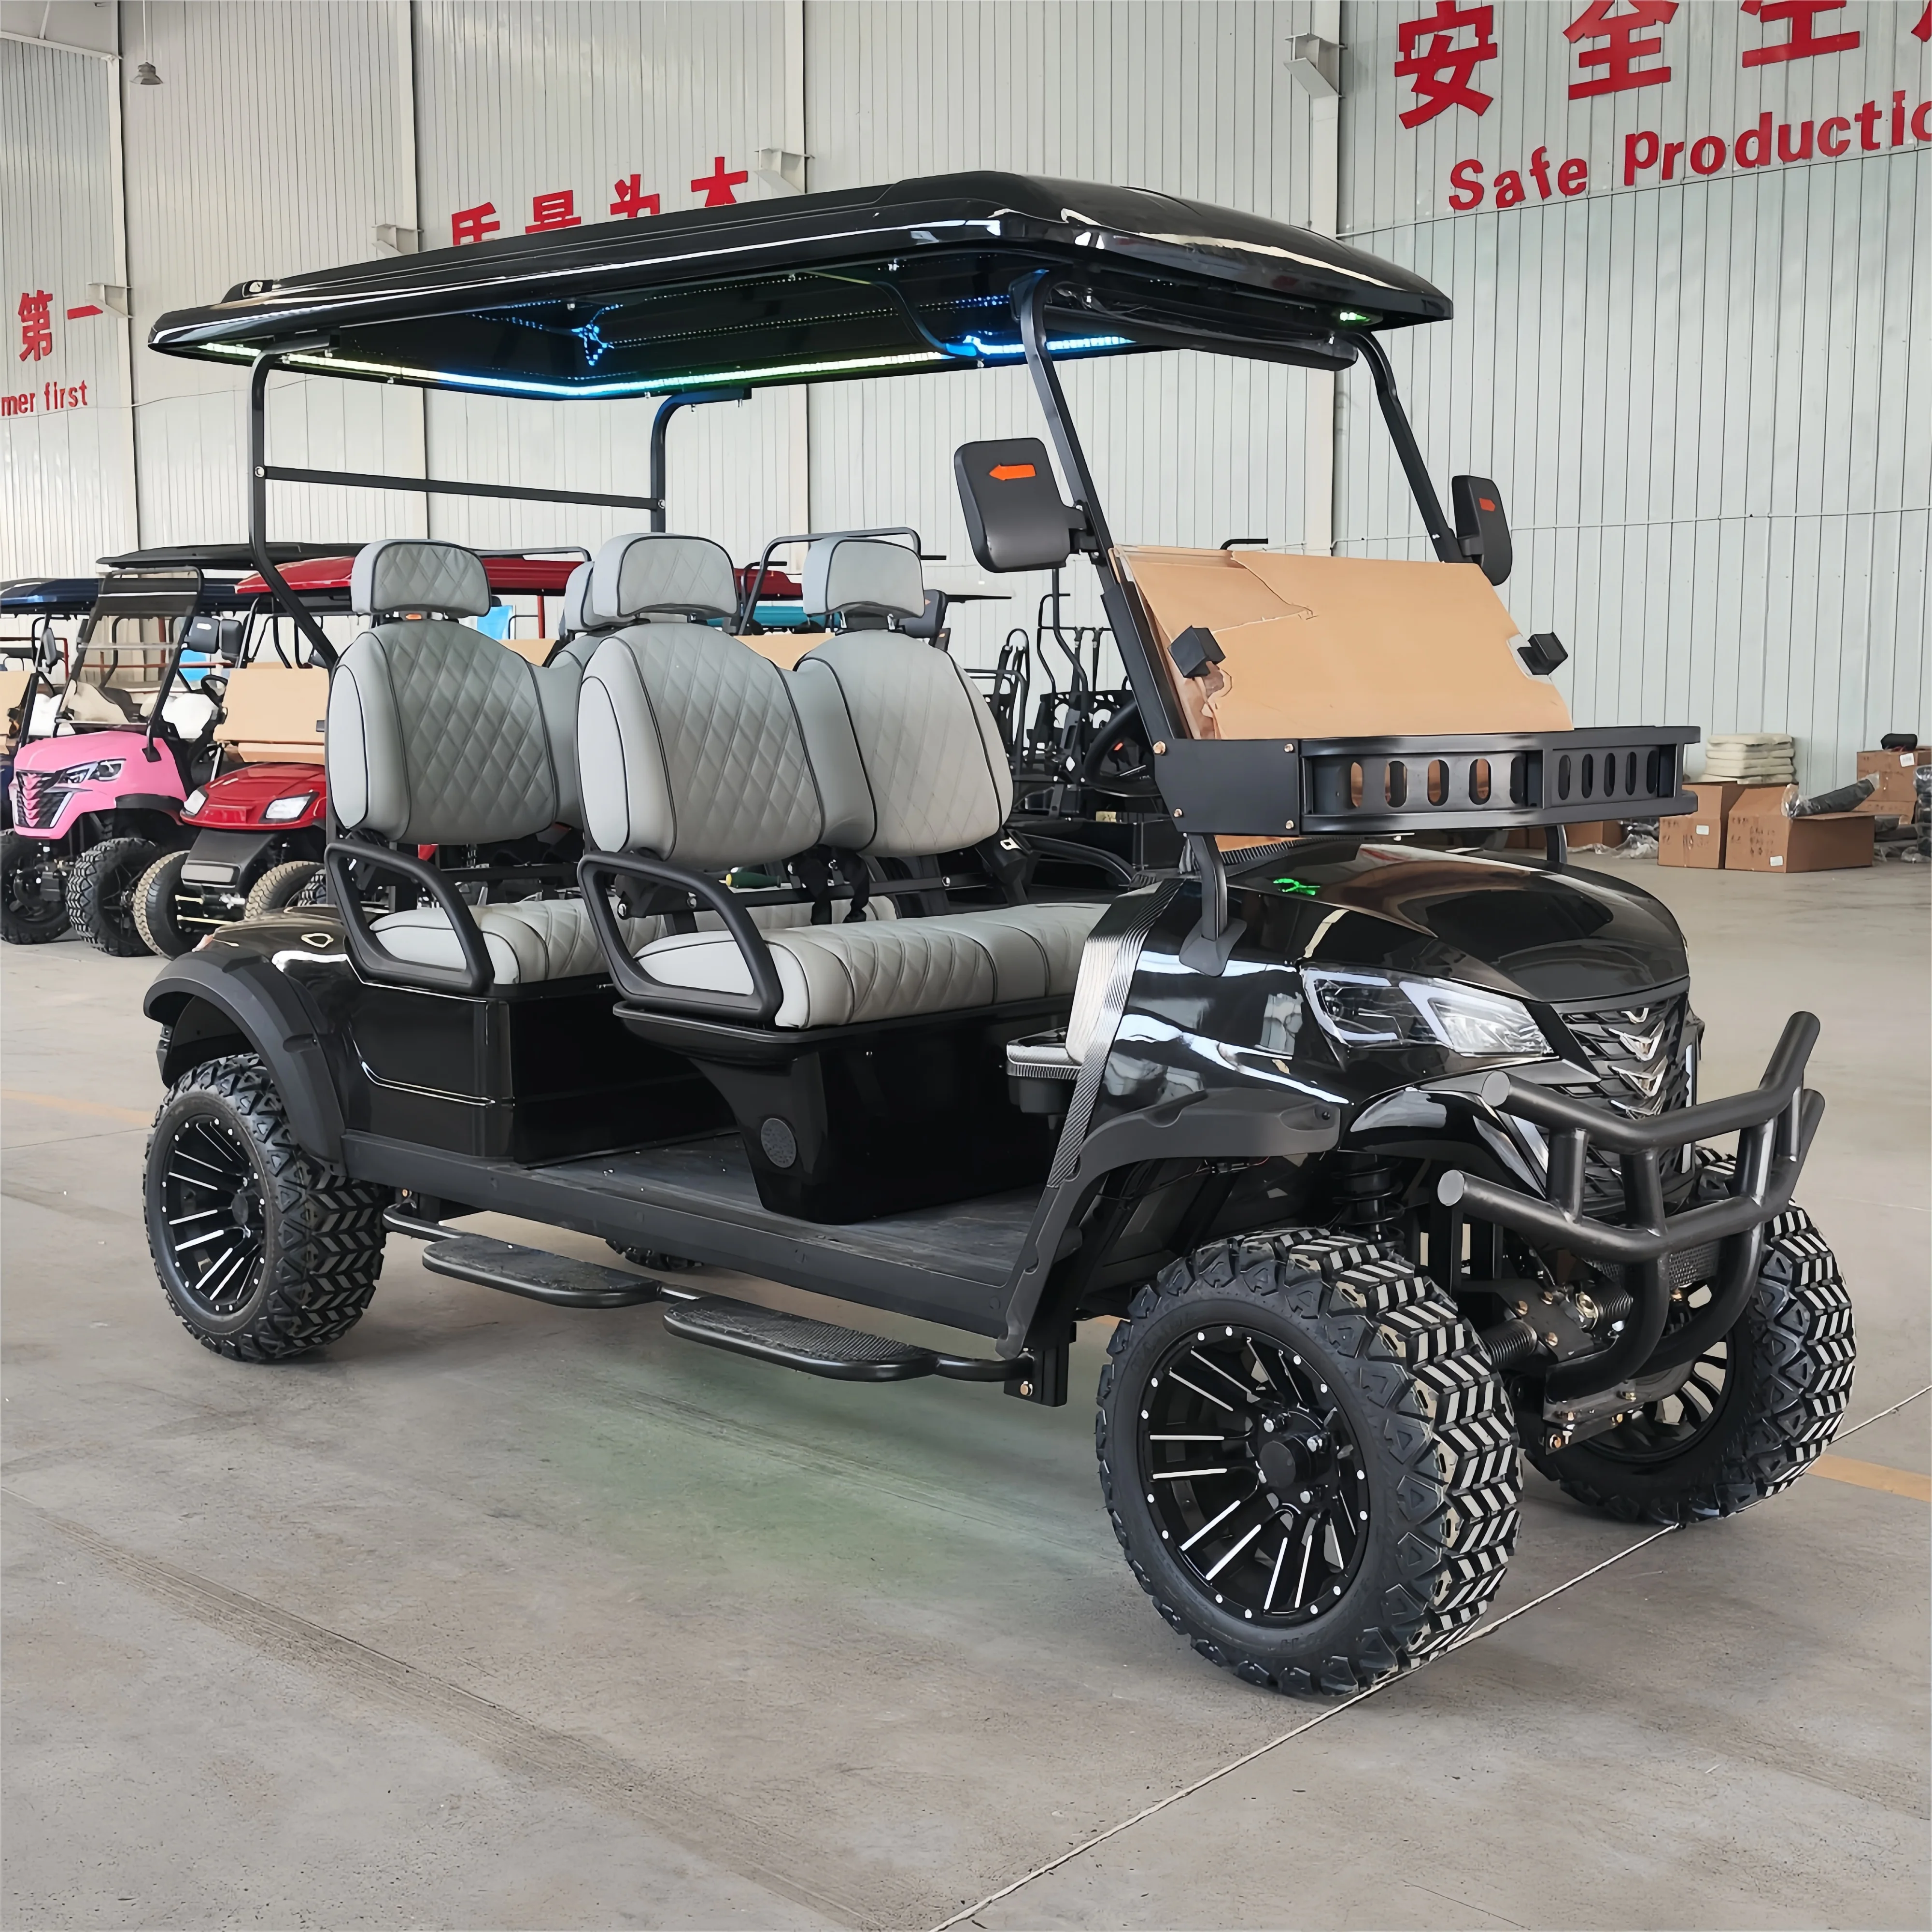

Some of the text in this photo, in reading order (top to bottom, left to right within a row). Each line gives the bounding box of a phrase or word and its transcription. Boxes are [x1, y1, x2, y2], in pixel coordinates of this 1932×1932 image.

[1449, 146, 1588, 211] Safe
[17, 289, 103, 361] 第一
[1, 380, 87, 416] mer first
